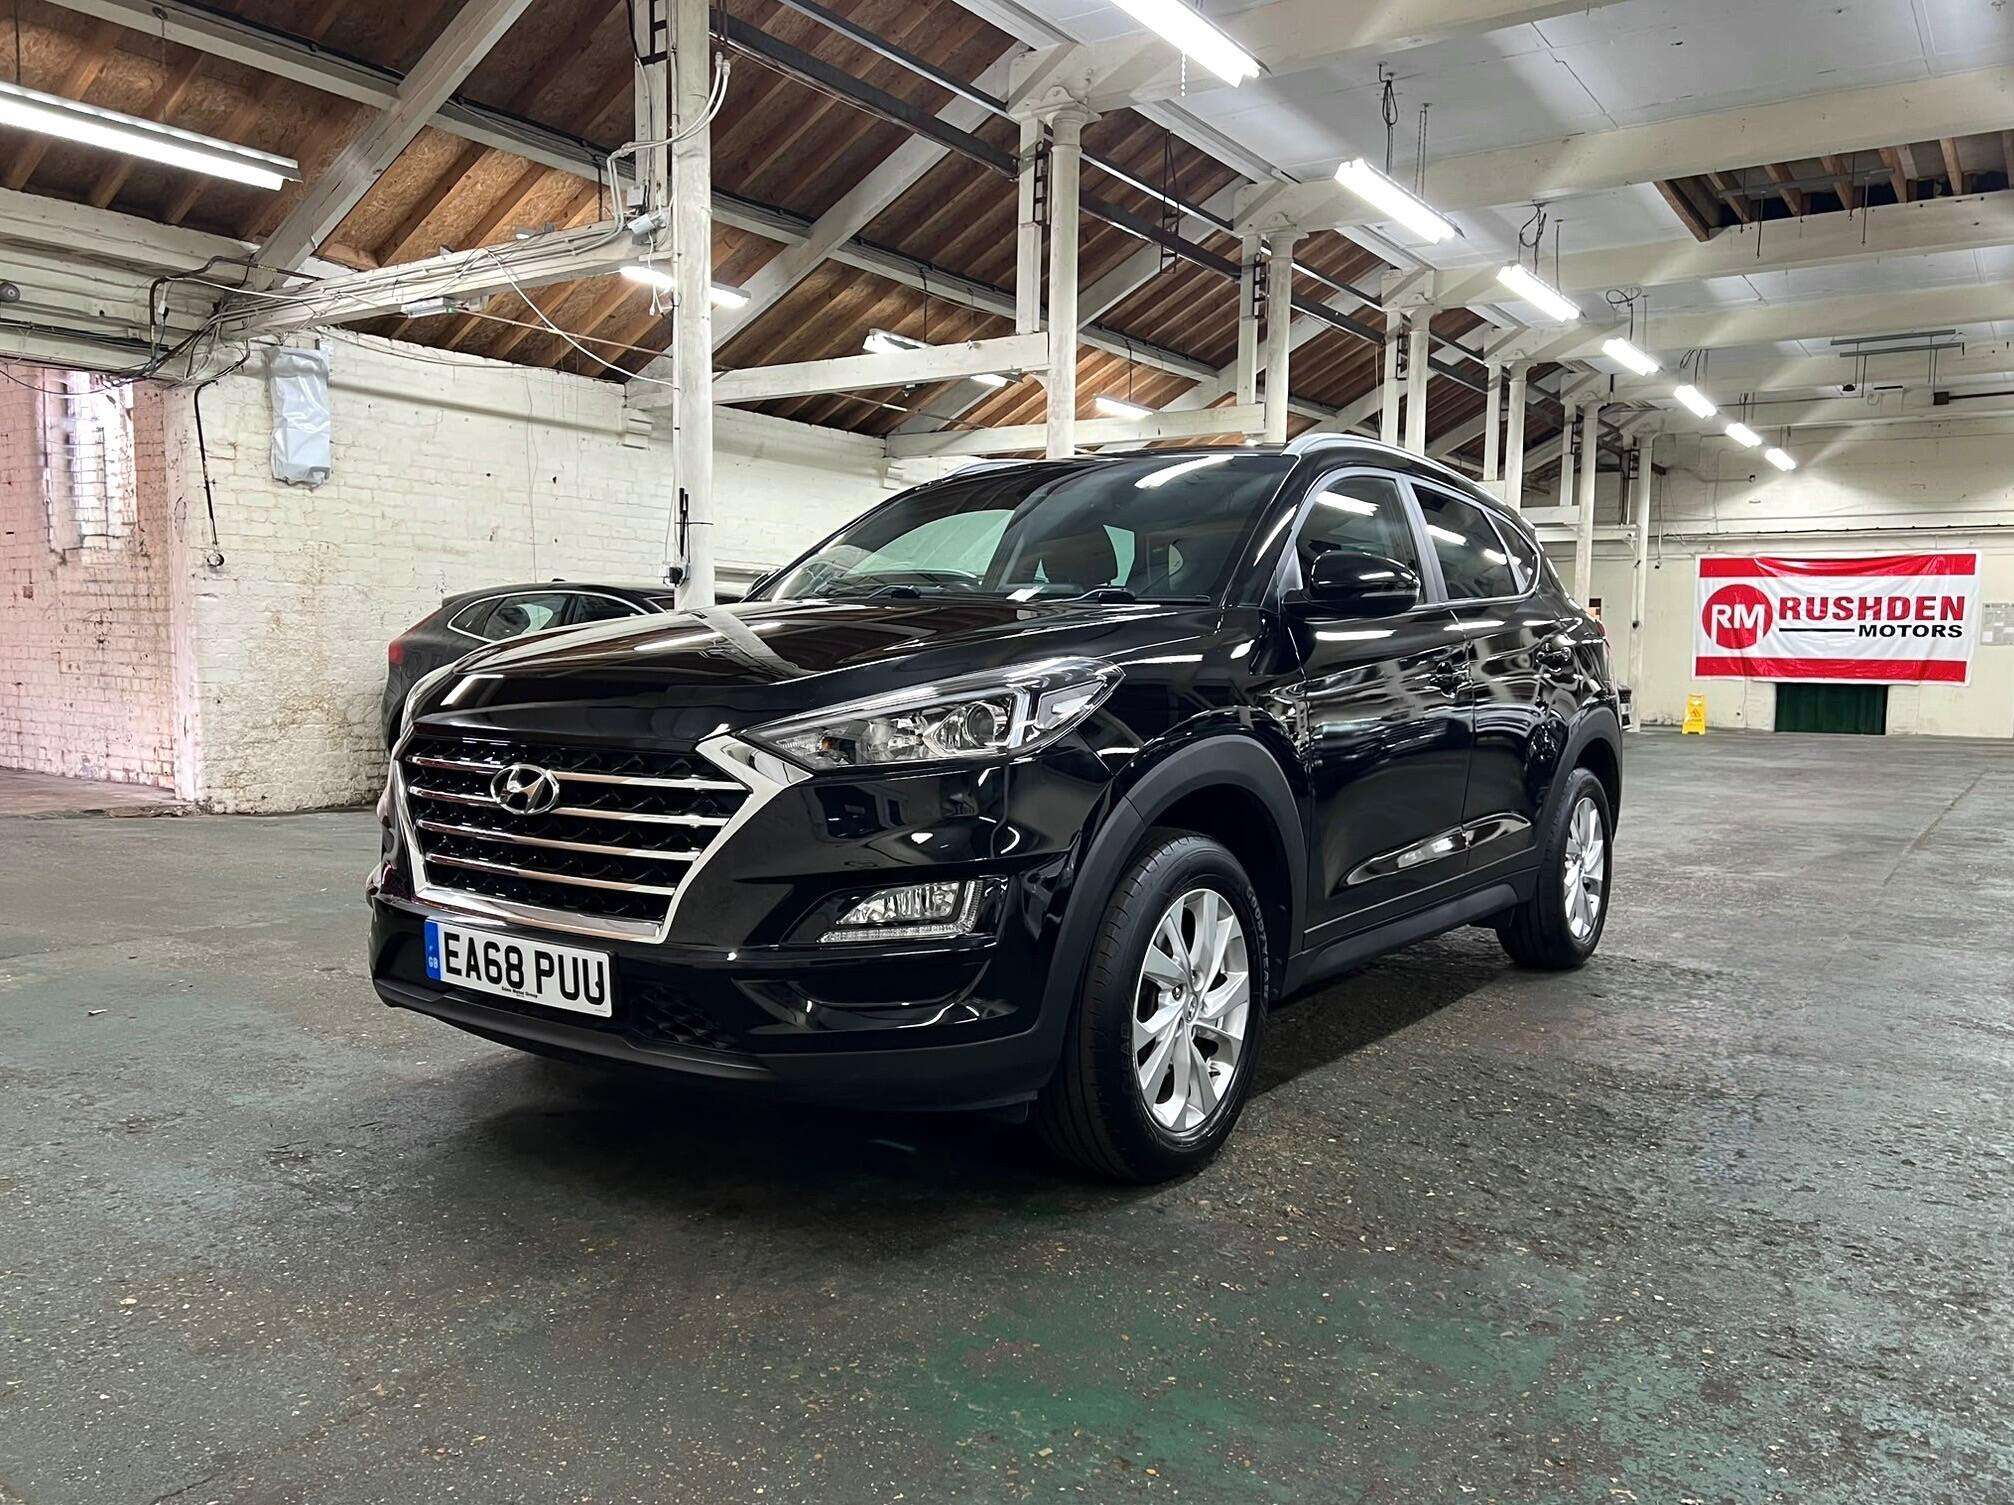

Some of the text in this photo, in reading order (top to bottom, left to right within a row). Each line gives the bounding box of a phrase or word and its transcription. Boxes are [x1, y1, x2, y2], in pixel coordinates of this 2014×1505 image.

[1778, 595, 1966, 621] RUSHDEN
[1711, 603, 1766, 641] RM
[1858, 624, 1963, 638] MOTORS
[428, 955, 439, 969] GB
[443, 931, 606, 1006] EA68 PUU
